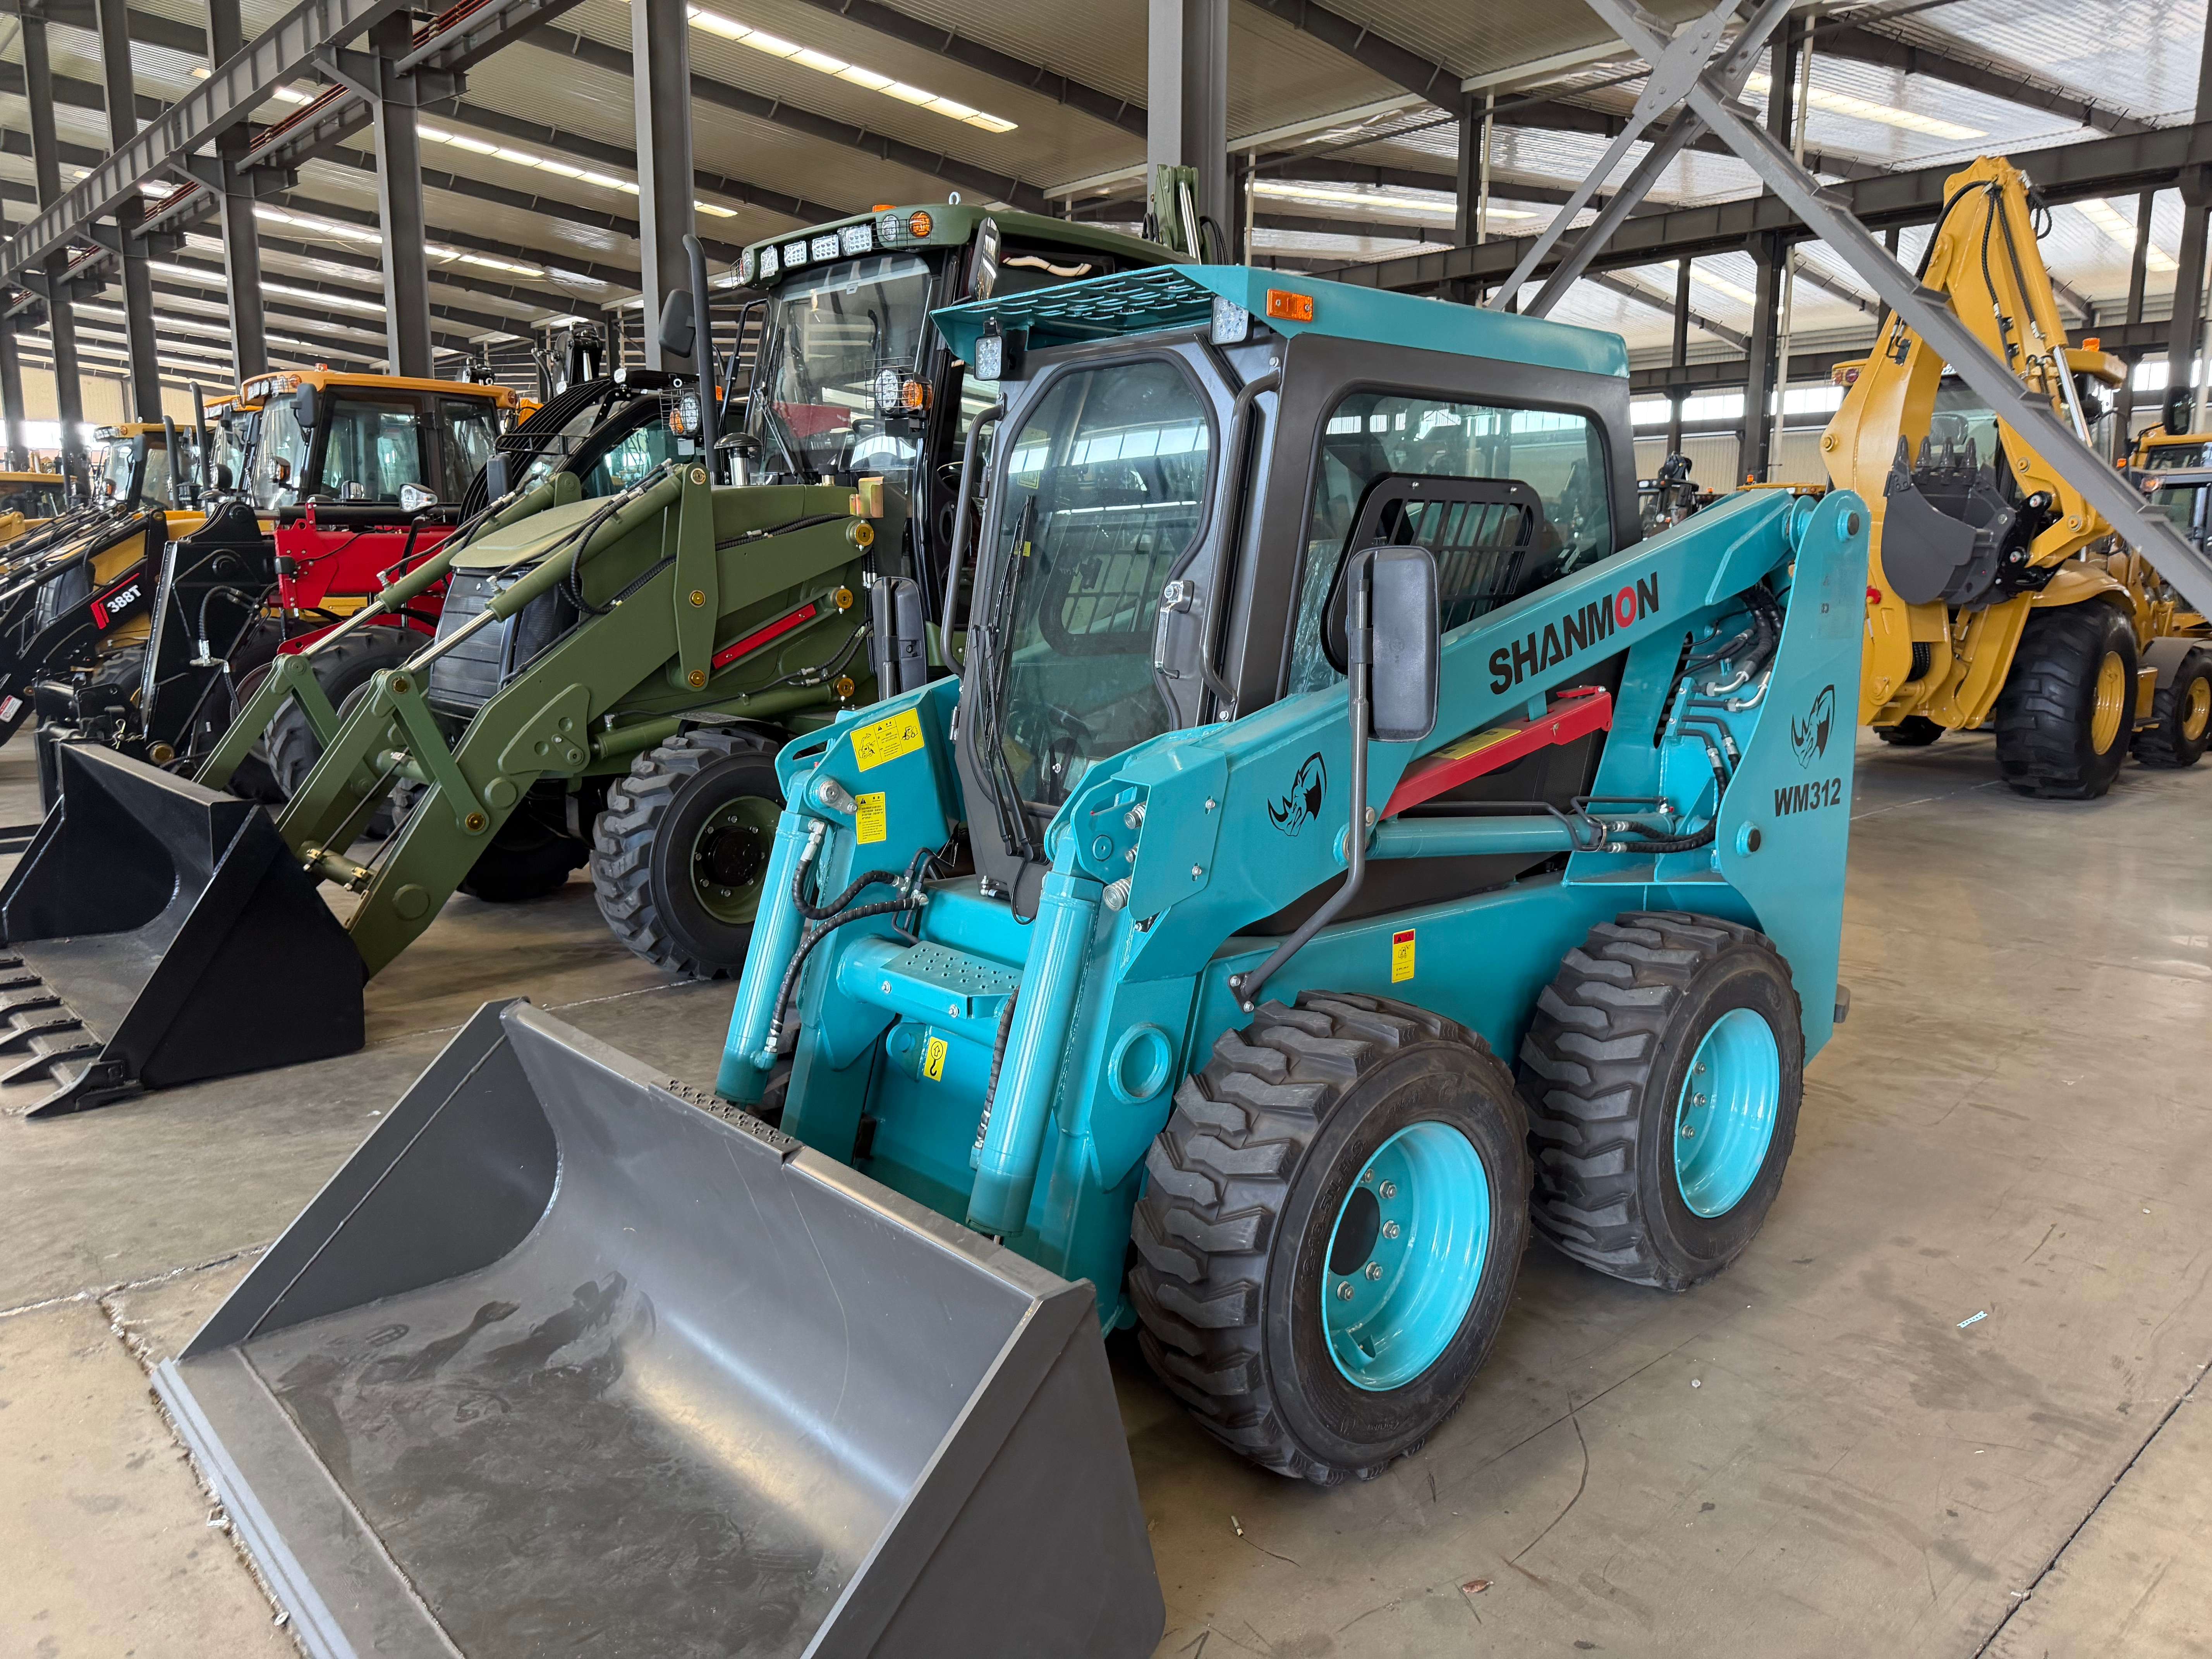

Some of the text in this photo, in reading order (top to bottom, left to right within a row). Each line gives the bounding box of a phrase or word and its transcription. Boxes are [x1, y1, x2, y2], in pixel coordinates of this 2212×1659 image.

[107, 584, 142, 613] 388T
[1489, 572, 1659, 694] SHANMON
[1774, 777, 1841, 817] WM312
